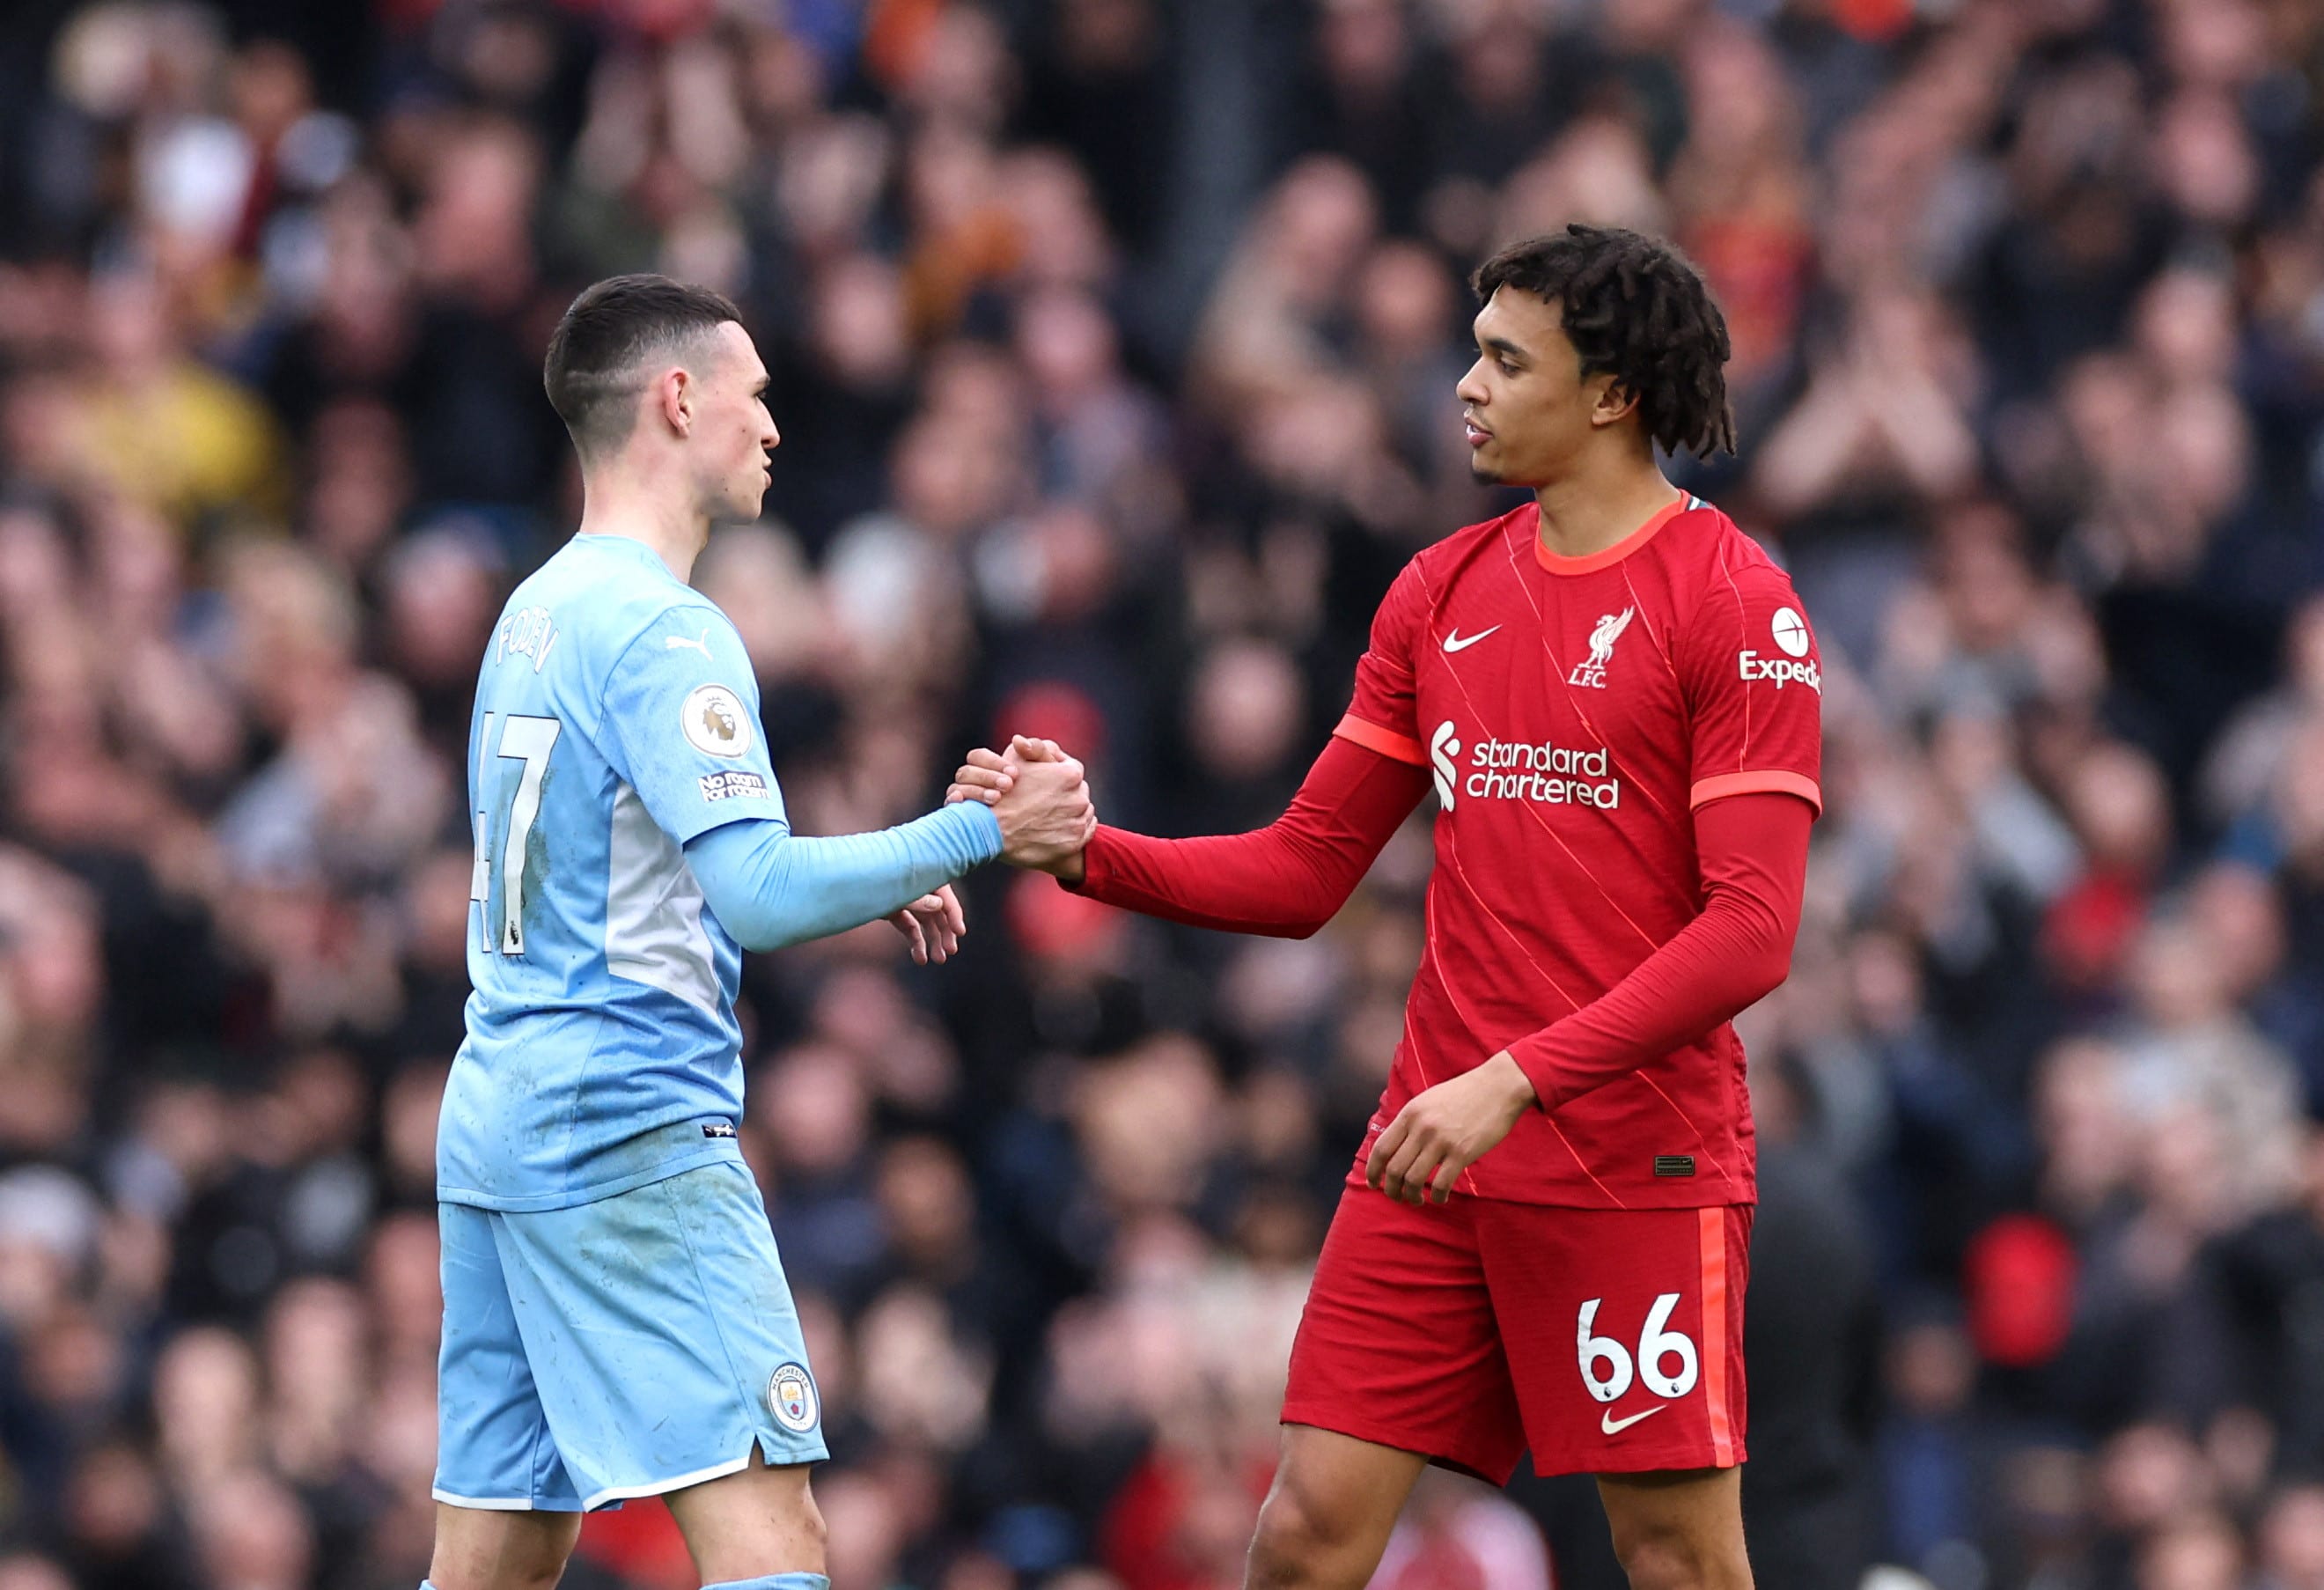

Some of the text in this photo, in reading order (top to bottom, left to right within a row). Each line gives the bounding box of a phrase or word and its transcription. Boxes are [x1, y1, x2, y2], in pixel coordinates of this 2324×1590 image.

[496, 605, 560, 675] FODEN
[1471, 737, 1607, 777] standard
[698, 773, 762, 790] No room
[1467, 769, 1619, 809] chartered
[1578, 1293, 1698, 1402] 66
[773, 1367, 808, 1390] MANCHESTER
